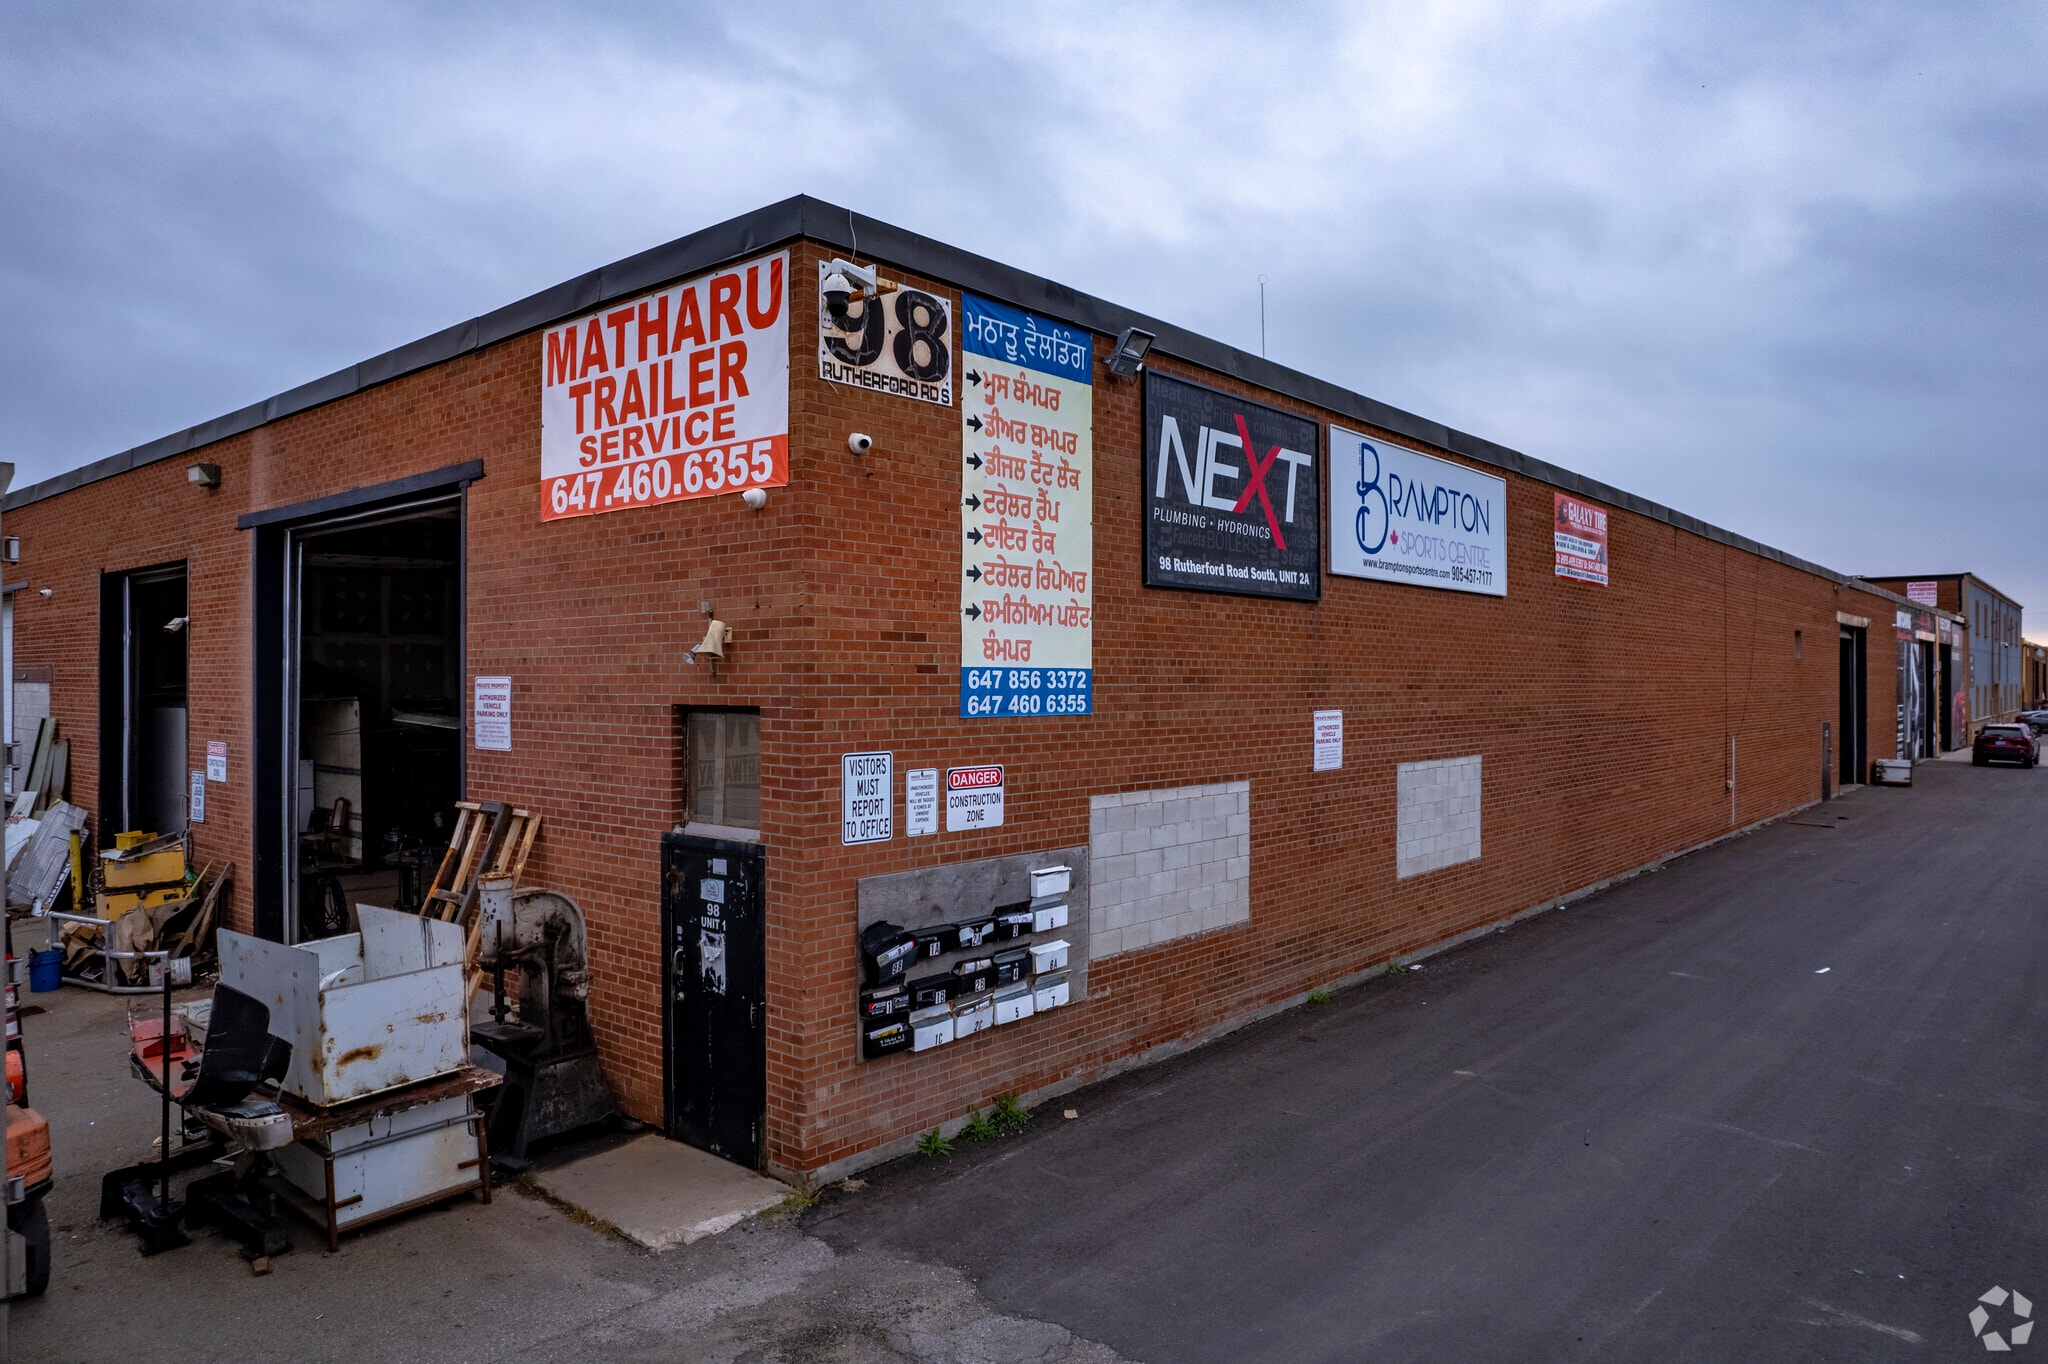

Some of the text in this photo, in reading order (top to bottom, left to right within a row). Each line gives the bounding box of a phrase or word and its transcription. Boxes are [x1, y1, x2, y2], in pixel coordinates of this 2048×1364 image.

[547, 257, 783, 387] MATHARU
[823, 289, 949, 382] 98
[568, 340, 750, 435] TRAILER
[822, 360, 950, 404] RUTHERFORD RD S
[578, 404, 736, 468] SERVICE
[551, 440, 774, 514] 647.460.6355
[1156, 413, 1312, 550] NEXT
[983, 482, 1033, 519] ਟਰੇਲਰ
[1153, 507, 1206, 529] PLUMBING
[1217, 519, 1271, 539] HYDRONICS
[1568, 502, 1593, 527] GALAXY
[1593, 510, 1607, 532] TIRE
[982, 517, 1056, 555] ਟਾਇਰ ਰੈਕ
[1400, 531, 1490, 569] SPORTS CENTRE
[983, 554, 1033, 589] ਟਰੇਲਰ
[1159, 556, 1172, 571] 98
[1173, 558, 1225, 577] Rutherford
[1226, 564, 1249, 579] Road
[1250, 567, 1278, 585] South,
[1279, 570, 1298, 584] UNIT
[1299, 572, 1310, 585] 2A
[1362, 558, 1493, 586] www.bramptonsportscentre.com 905-457-7177
[968, 669, 1087, 689] 647 856 3372
[476, 710, 495, 718] PARKING
[967, 694, 1087, 715] 647 460 6355
[849, 757, 887, 777] VISITORS
[857, 779, 879, 796] MUST
[952, 771, 998, 786] DANGER
[852, 798, 884, 817] REPORT
[950, 792, 1001, 809] CONSTRUCTION
[966, 809, 984, 822] ZONE
[846, 818, 889, 838] TO OFFICE
[706, 903, 720, 917] 98
[701, 916, 727, 932] UNIT 1
[1050, 958, 1058, 970] 6A
[1051, 996, 1056, 1007] 7
[1015, 1007, 1020, 1018] 5
[974, 1020, 983, 1032] 2C
[935, 1033, 943, 1045] 1C
